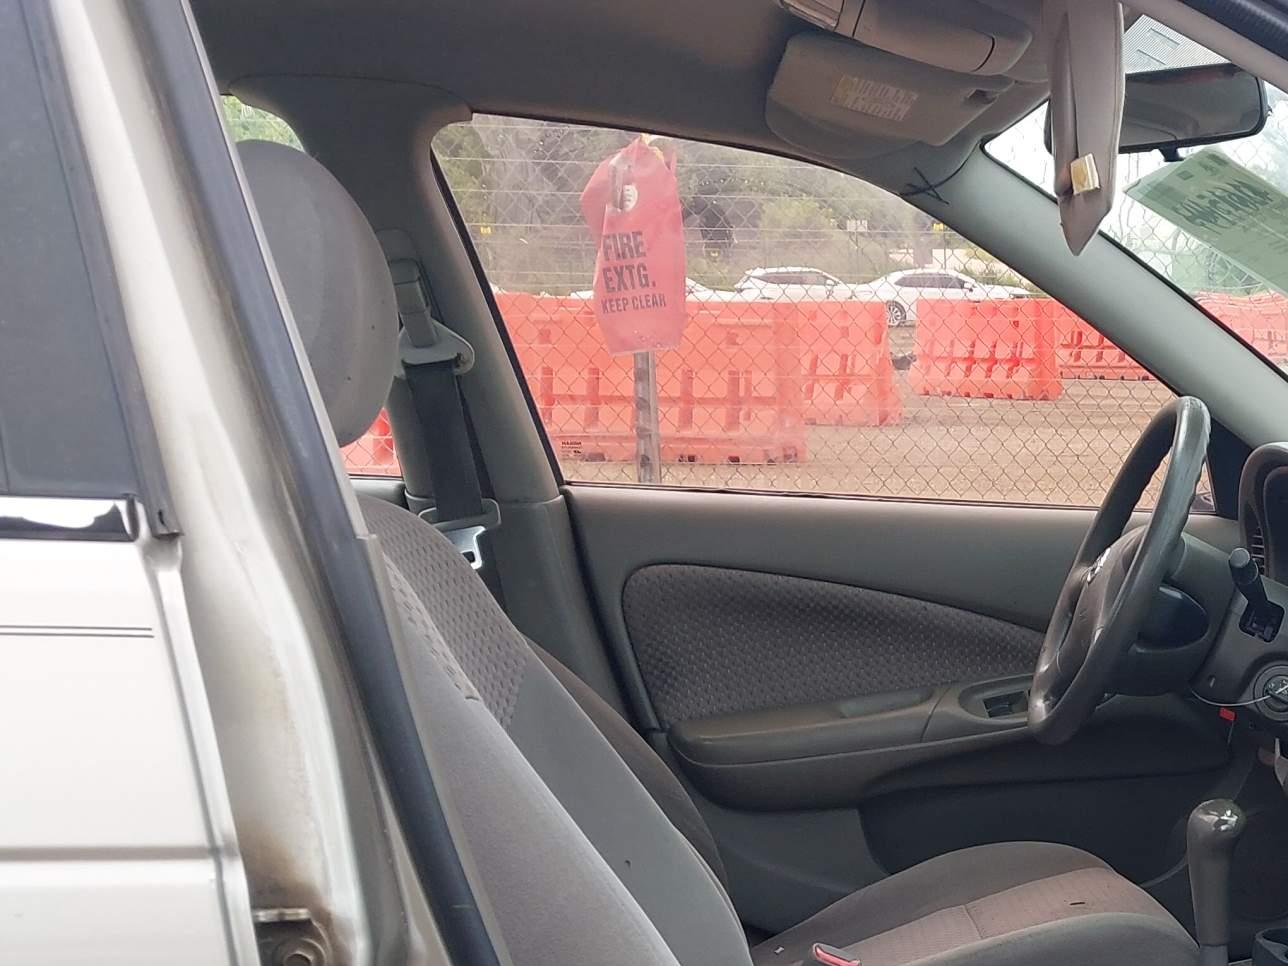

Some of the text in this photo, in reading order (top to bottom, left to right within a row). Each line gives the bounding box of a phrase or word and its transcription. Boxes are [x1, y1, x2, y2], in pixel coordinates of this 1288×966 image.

[602, 230, 647, 262] FIRE
[602, 262, 656, 294] EXTG.
[601, 292, 667, 314] KEEP CLEAR
